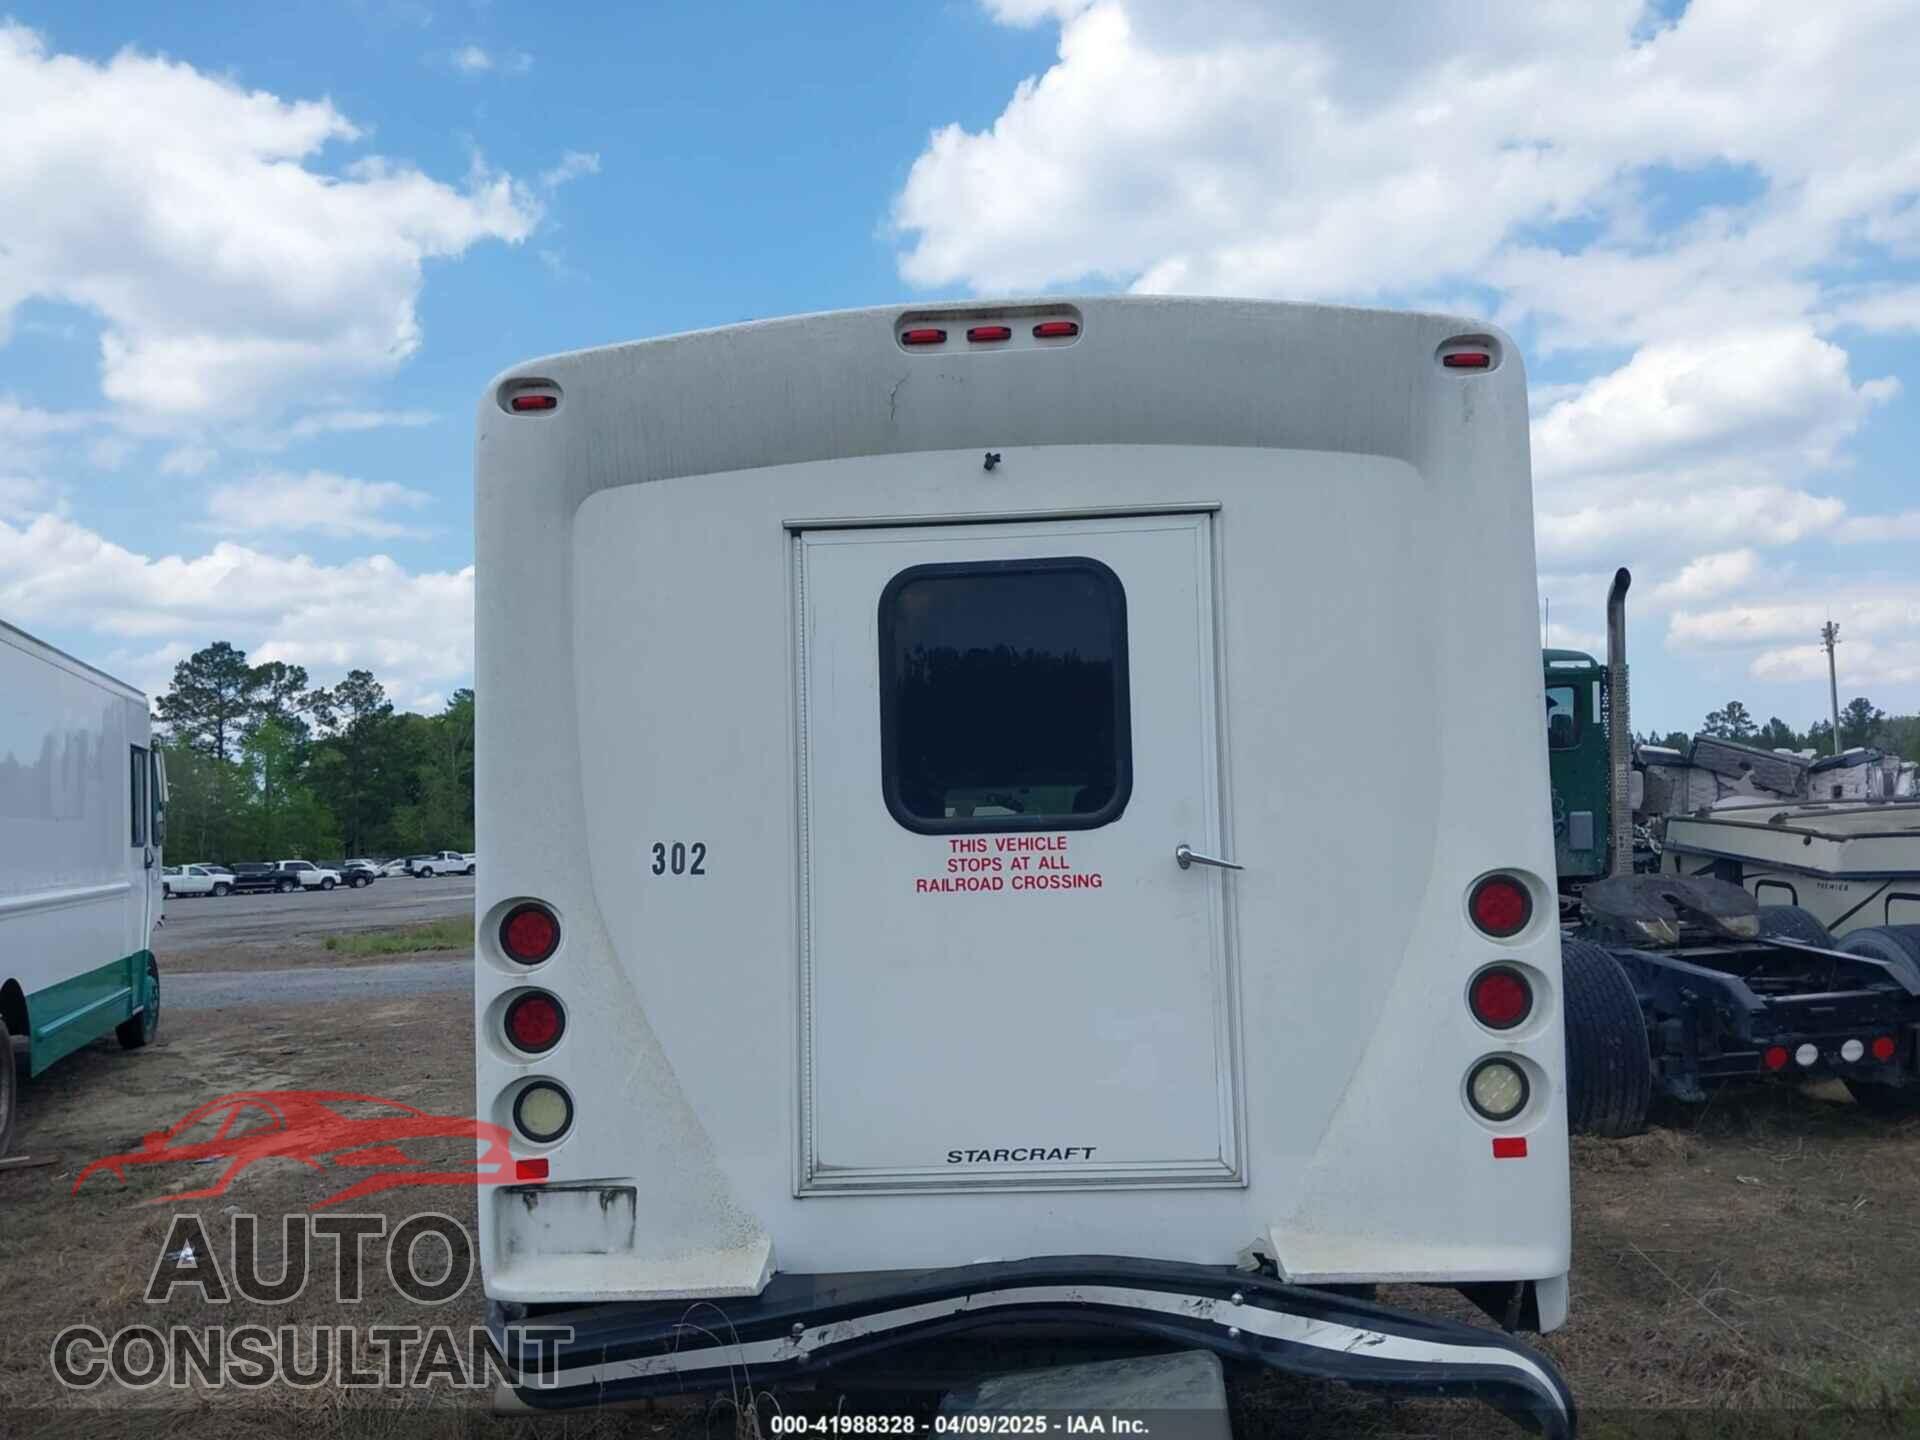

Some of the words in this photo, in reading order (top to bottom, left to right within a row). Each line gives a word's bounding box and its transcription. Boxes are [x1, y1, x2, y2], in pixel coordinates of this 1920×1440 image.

[950, 838, 988, 853] THIS
[995, 836, 1068, 851] VEHICLE
[652, 842, 707, 876] 302
[947, 857, 1003, 873] STOPS
[1010, 857, 1031, 871] AT
[1038, 856, 1071, 870] ALL
[916, 877, 1004, 893] RAILROAD
[1012, 873, 1103, 890] CROSSING
[946, 1146, 1097, 1164] STARCRAFT
